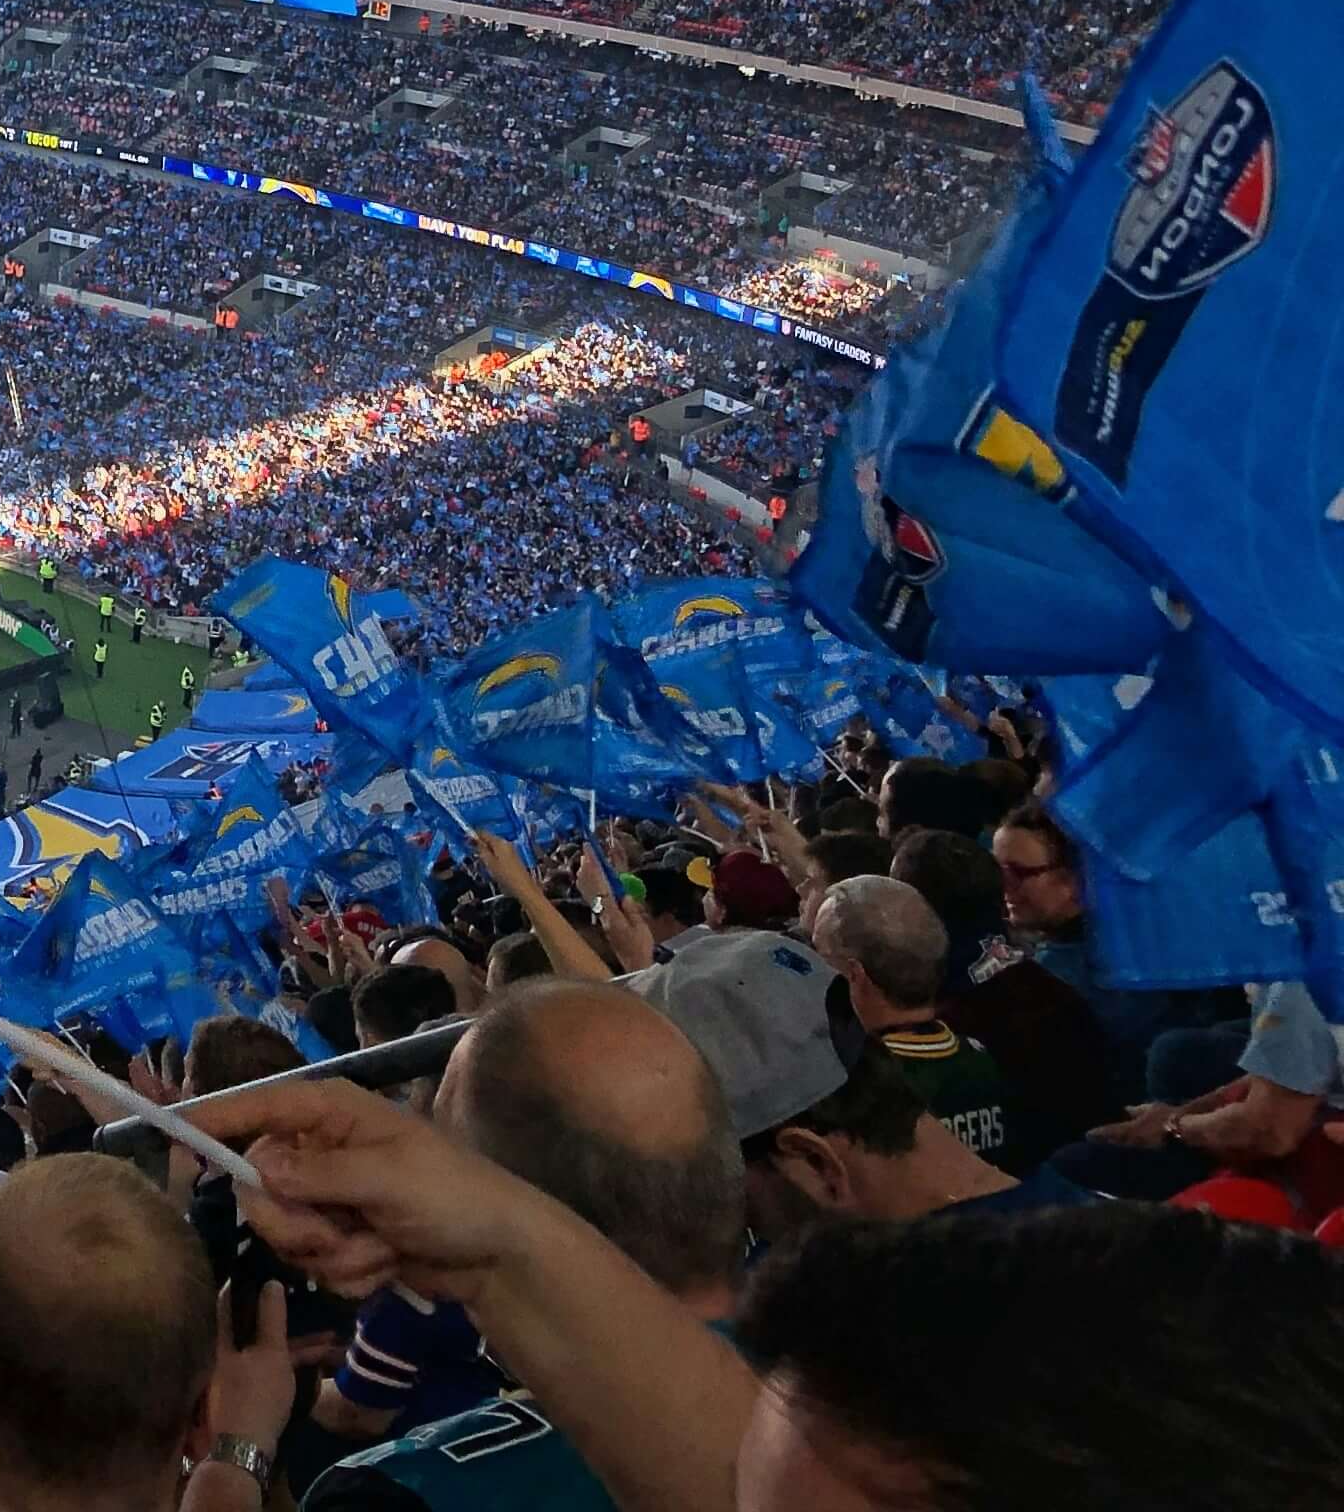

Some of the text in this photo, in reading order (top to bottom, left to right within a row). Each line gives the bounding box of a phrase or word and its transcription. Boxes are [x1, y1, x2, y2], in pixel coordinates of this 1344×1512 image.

[26, 131, 59, 149] 15:00
[418, 214, 525, 255] WAVE YOUR FLAG
[794, 325, 834, 349] FANTASY
[833, 339, 872, 365] LEADERS
